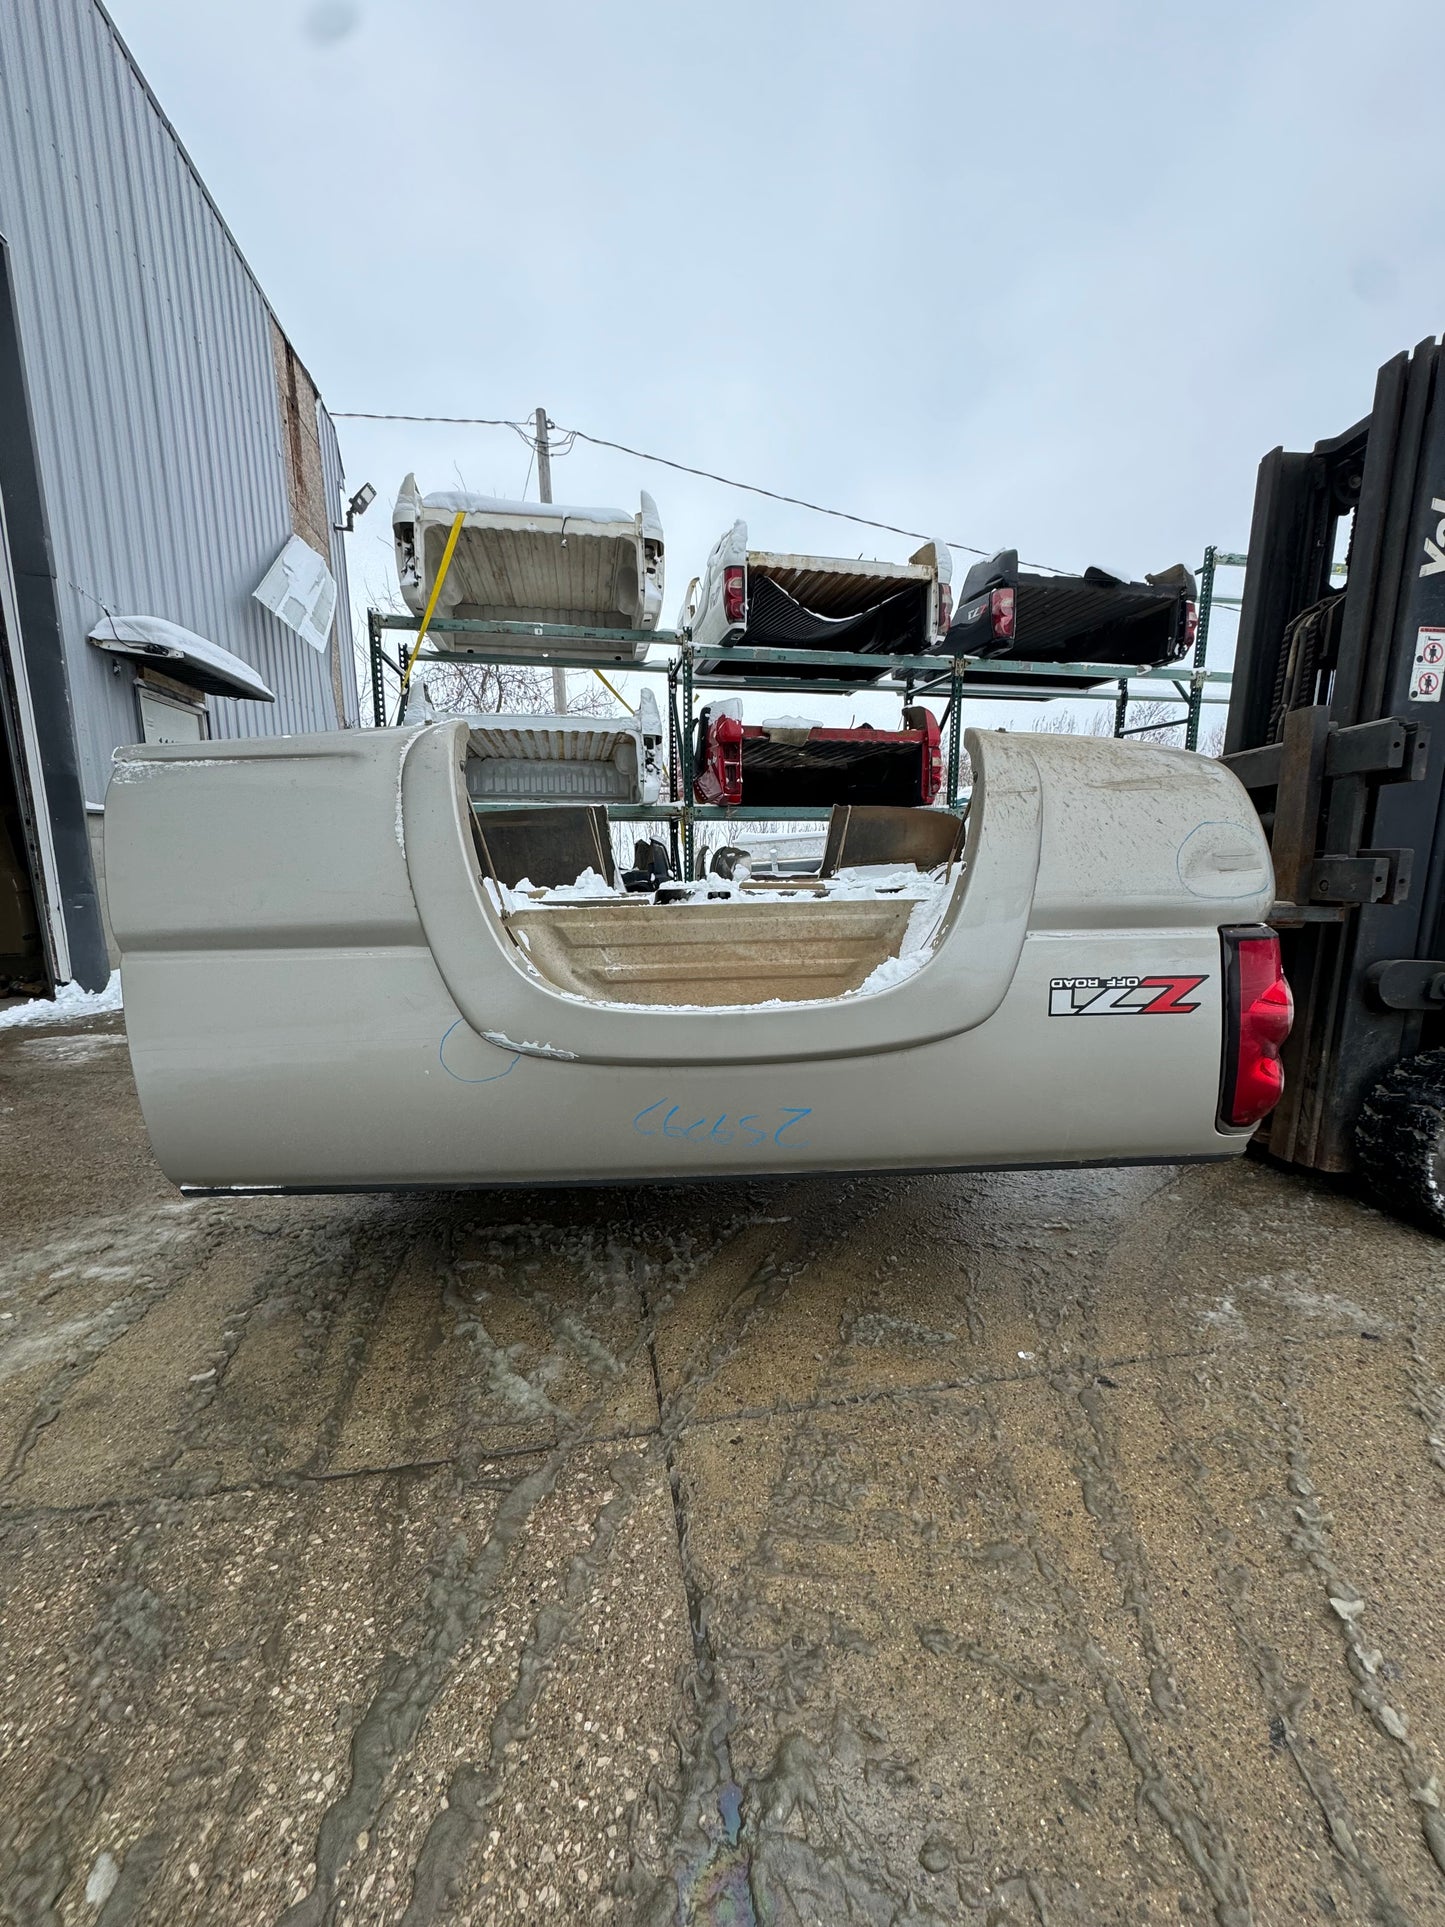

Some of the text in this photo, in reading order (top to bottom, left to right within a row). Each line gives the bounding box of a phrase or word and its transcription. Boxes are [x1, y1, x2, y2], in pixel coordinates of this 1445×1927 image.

[1050, 977, 1139, 988] OFF ROAD
[1048, 975, 1210, 1017] Z71
